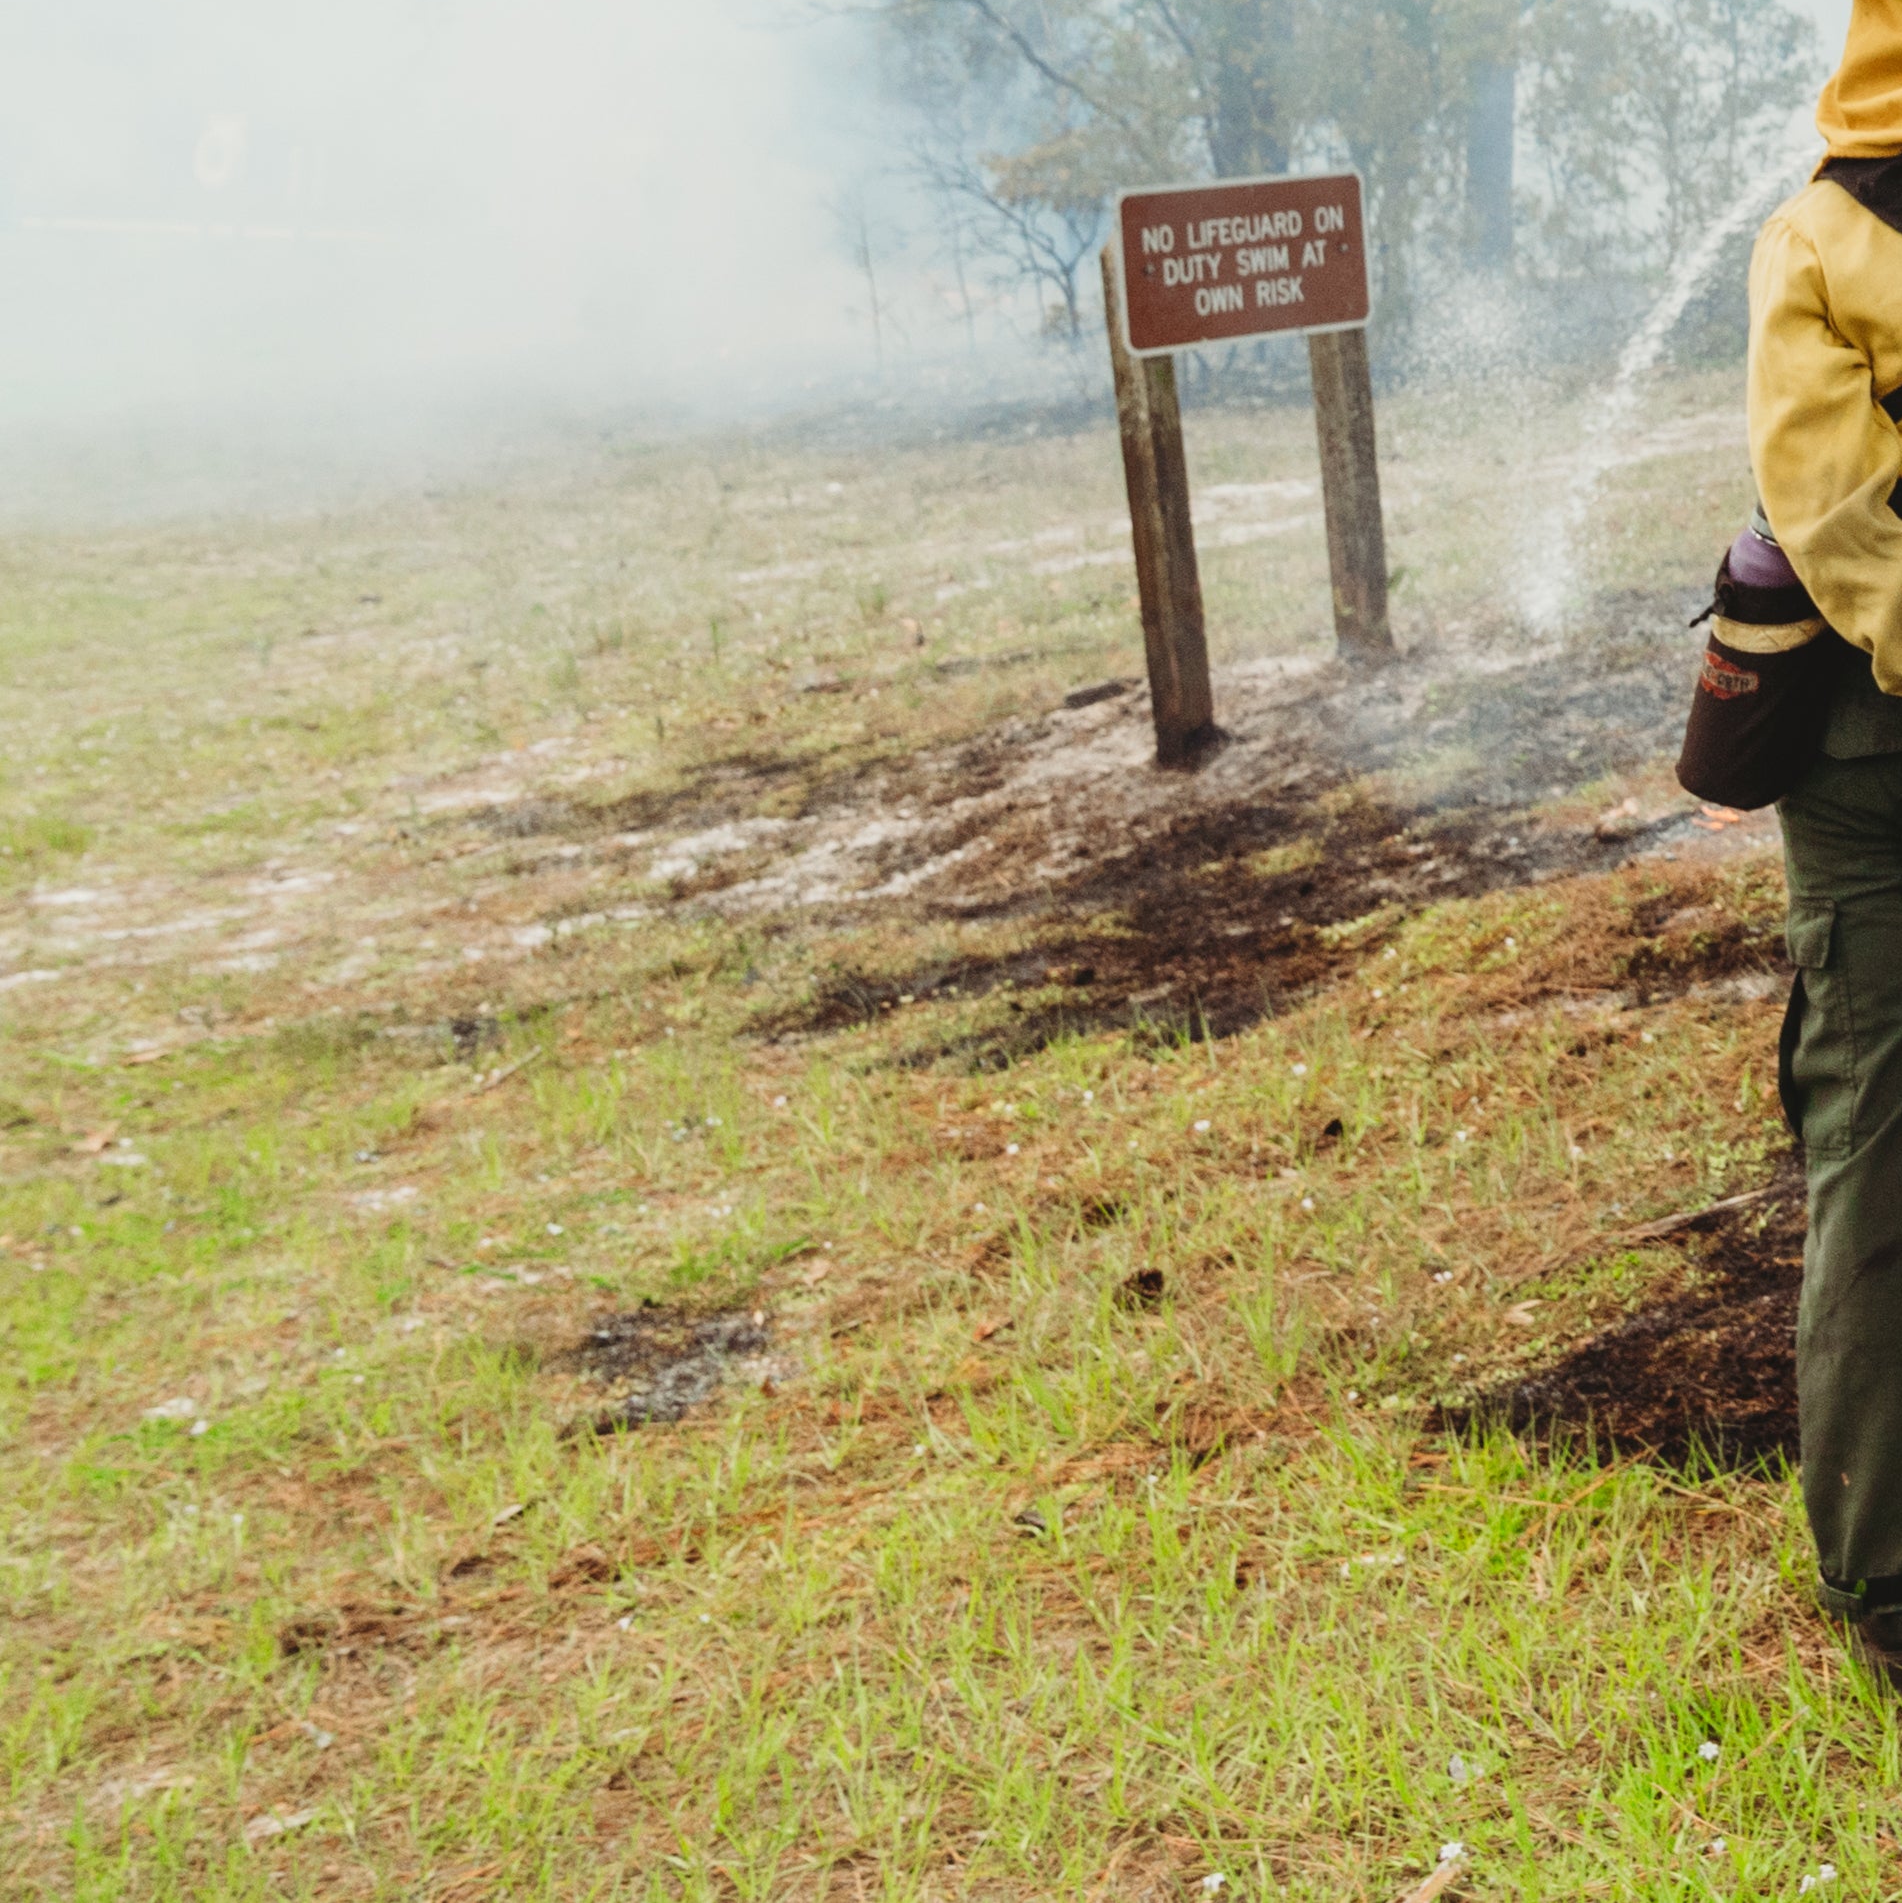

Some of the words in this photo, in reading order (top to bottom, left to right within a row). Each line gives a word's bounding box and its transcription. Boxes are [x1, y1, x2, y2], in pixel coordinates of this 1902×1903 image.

[1142, 224, 1174, 254] NO
[1187, 210, 1302, 249] LIFEGUARD
[1314, 204, 1343, 233] ON
[1163, 252, 1221, 286] DUTY
[1236, 244, 1289, 276] SWIM
[1302, 239, 1326, 268] AT
[1195, 284, 1243, 316] OWN
[1256, 276, 1304, 307] RISK
